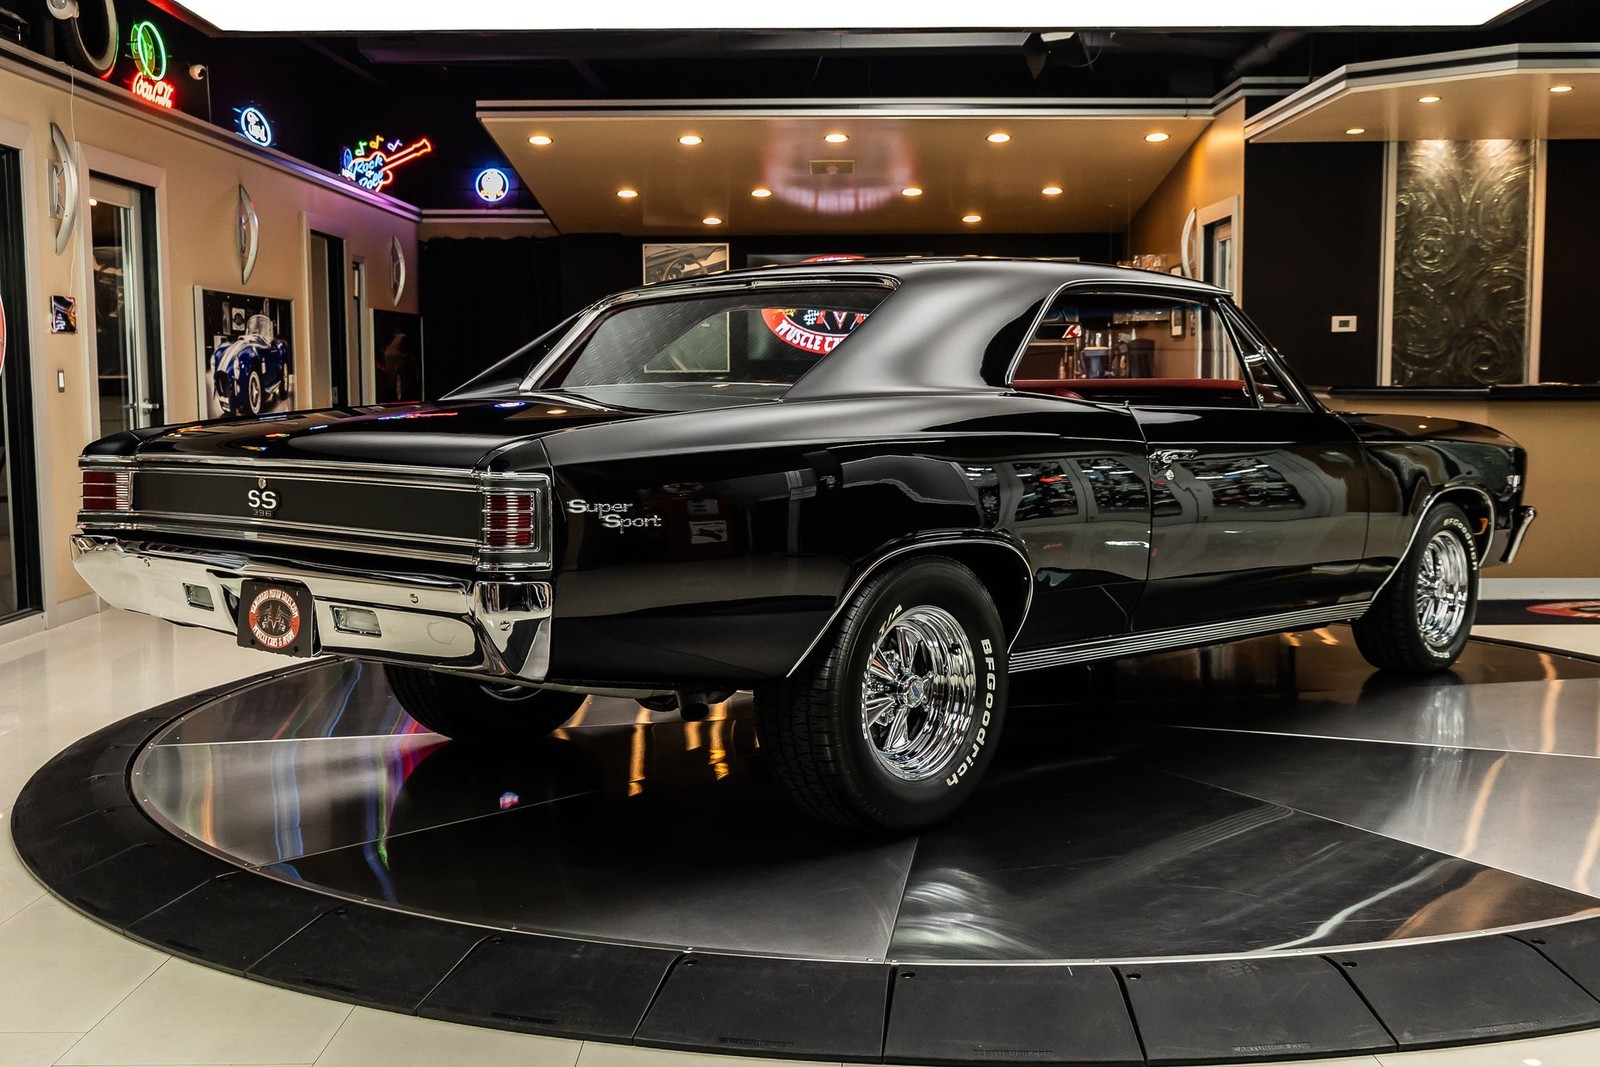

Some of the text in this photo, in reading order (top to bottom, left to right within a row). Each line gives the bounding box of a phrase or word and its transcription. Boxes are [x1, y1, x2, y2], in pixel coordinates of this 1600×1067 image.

[775, 319, 823, 351] MUSCLE
[248, 489, 277, 509] SS
[567, 499, 633, 519] Super
[252, 509, 272, 517] 396
[602, 514, 662, 534] Sport
[946, 638, 996, 787] BFGoodrich
